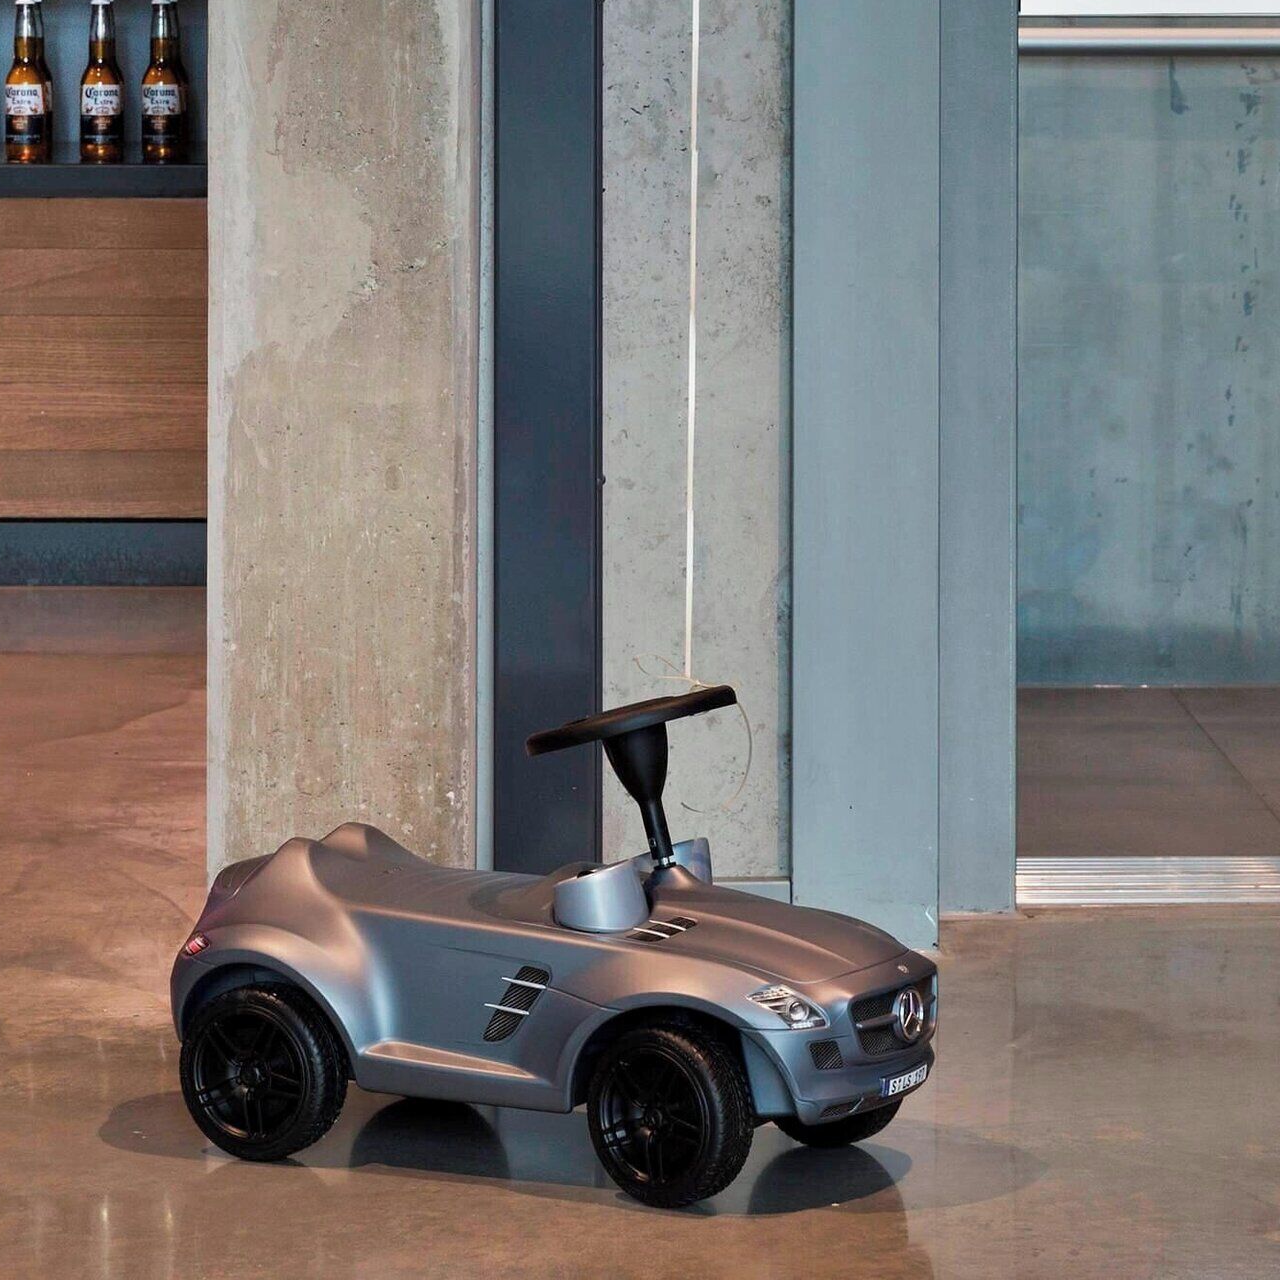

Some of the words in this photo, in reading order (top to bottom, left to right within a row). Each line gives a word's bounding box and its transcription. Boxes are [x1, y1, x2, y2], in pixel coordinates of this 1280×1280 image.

[6, 86, 38, 96] Corona
[85, 87, 120, 97] Corona
[144, 87, 176, 97] Corona
